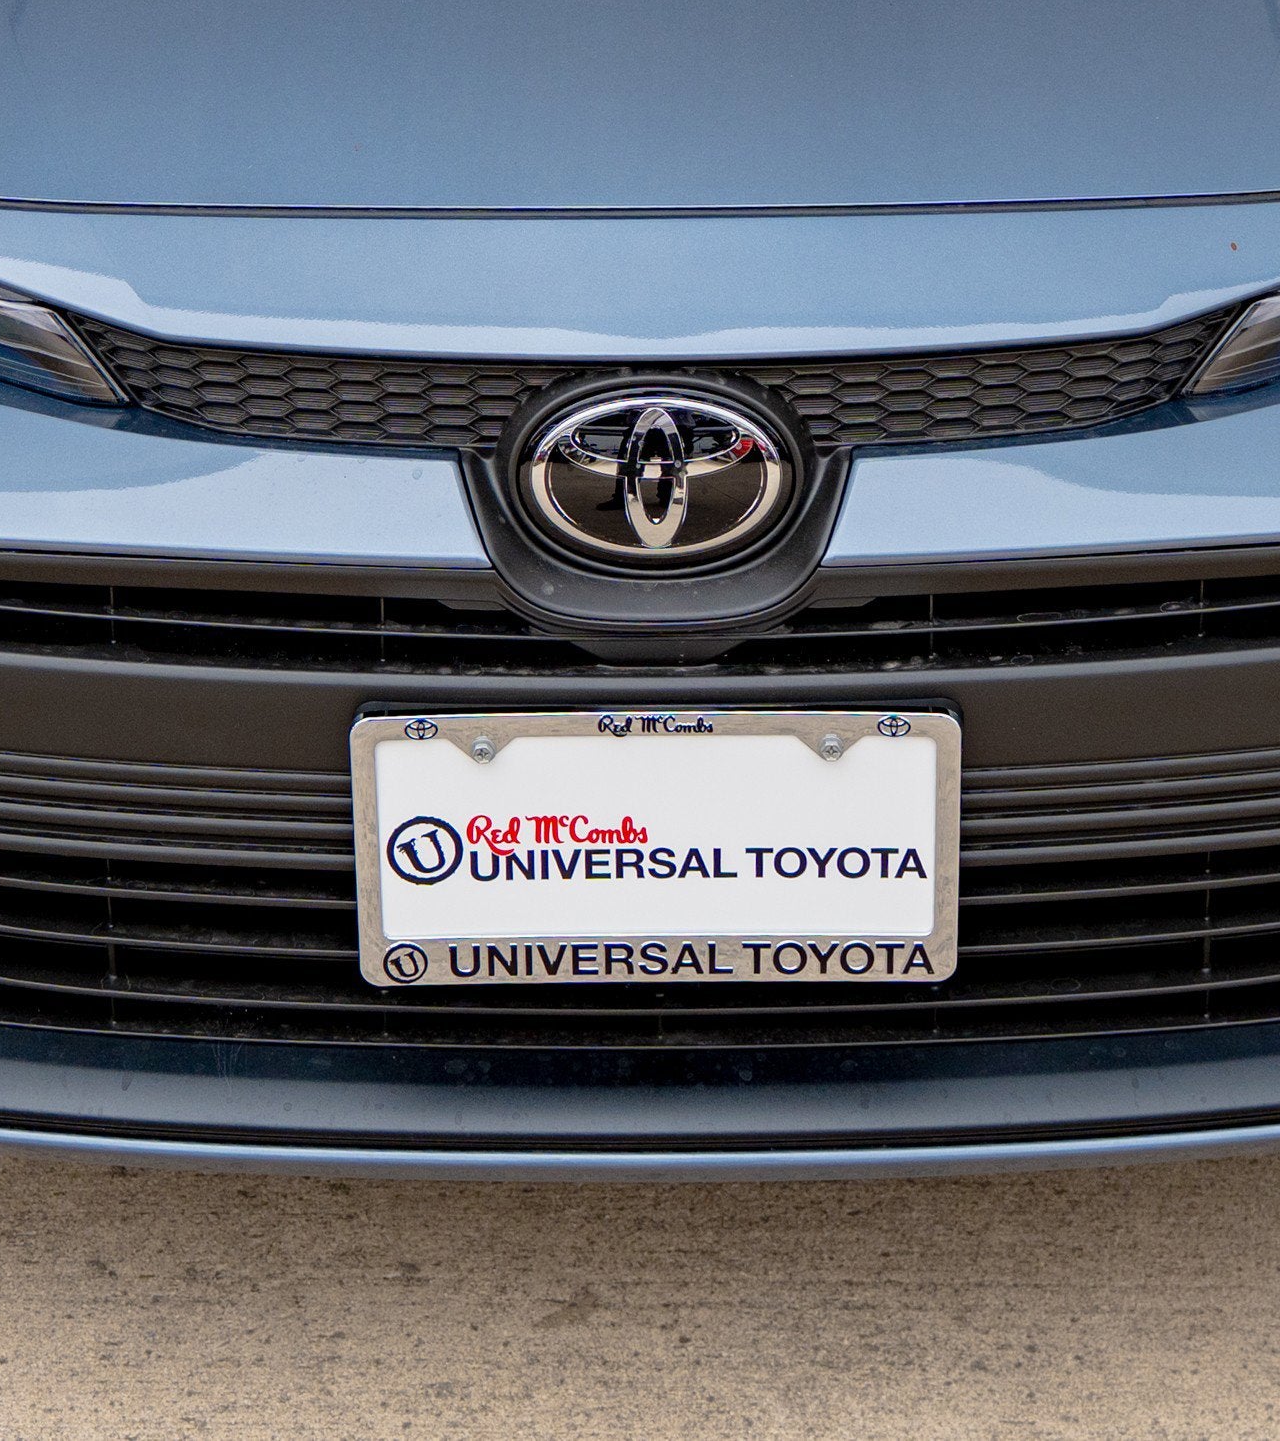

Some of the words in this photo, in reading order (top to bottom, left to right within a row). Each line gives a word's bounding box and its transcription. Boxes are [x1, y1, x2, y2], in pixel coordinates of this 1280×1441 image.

[598, 713, 635, 736] Red
[466, 815, 520, 856] Red
[525, 815, 649, 845] McCombs
[470, 847, 737, 882] UNIVERSAL
[745, 846, 928, 880] TOYOTA
[449, 942, 734, 978] UNIVERSAL
[742, 941, 935, 976] TOYOTA
